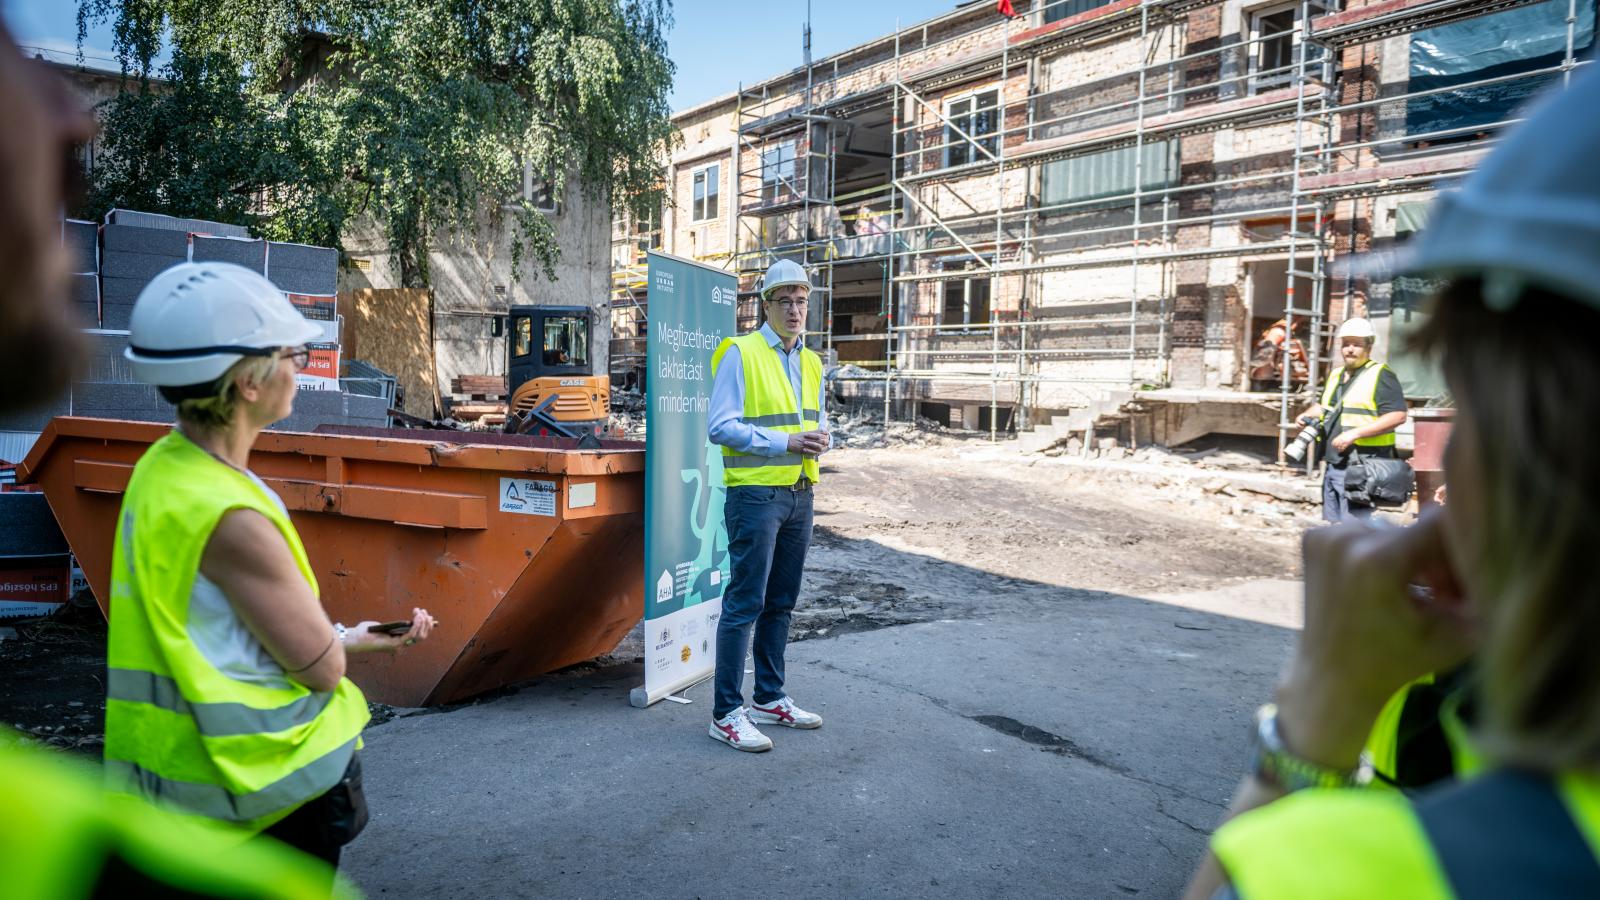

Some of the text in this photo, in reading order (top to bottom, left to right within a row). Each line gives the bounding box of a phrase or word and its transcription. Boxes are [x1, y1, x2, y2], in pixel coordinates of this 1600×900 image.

[658, 321, 722, 352] Megfizethető
[658, 354, 704, 381] lakhatást
[560, 379, 586, 387] CASE
[658, 391, 711, 413] mindenkin
[40, 583, 58, 591] EPS
[659, 586, 672, 600] AHA
